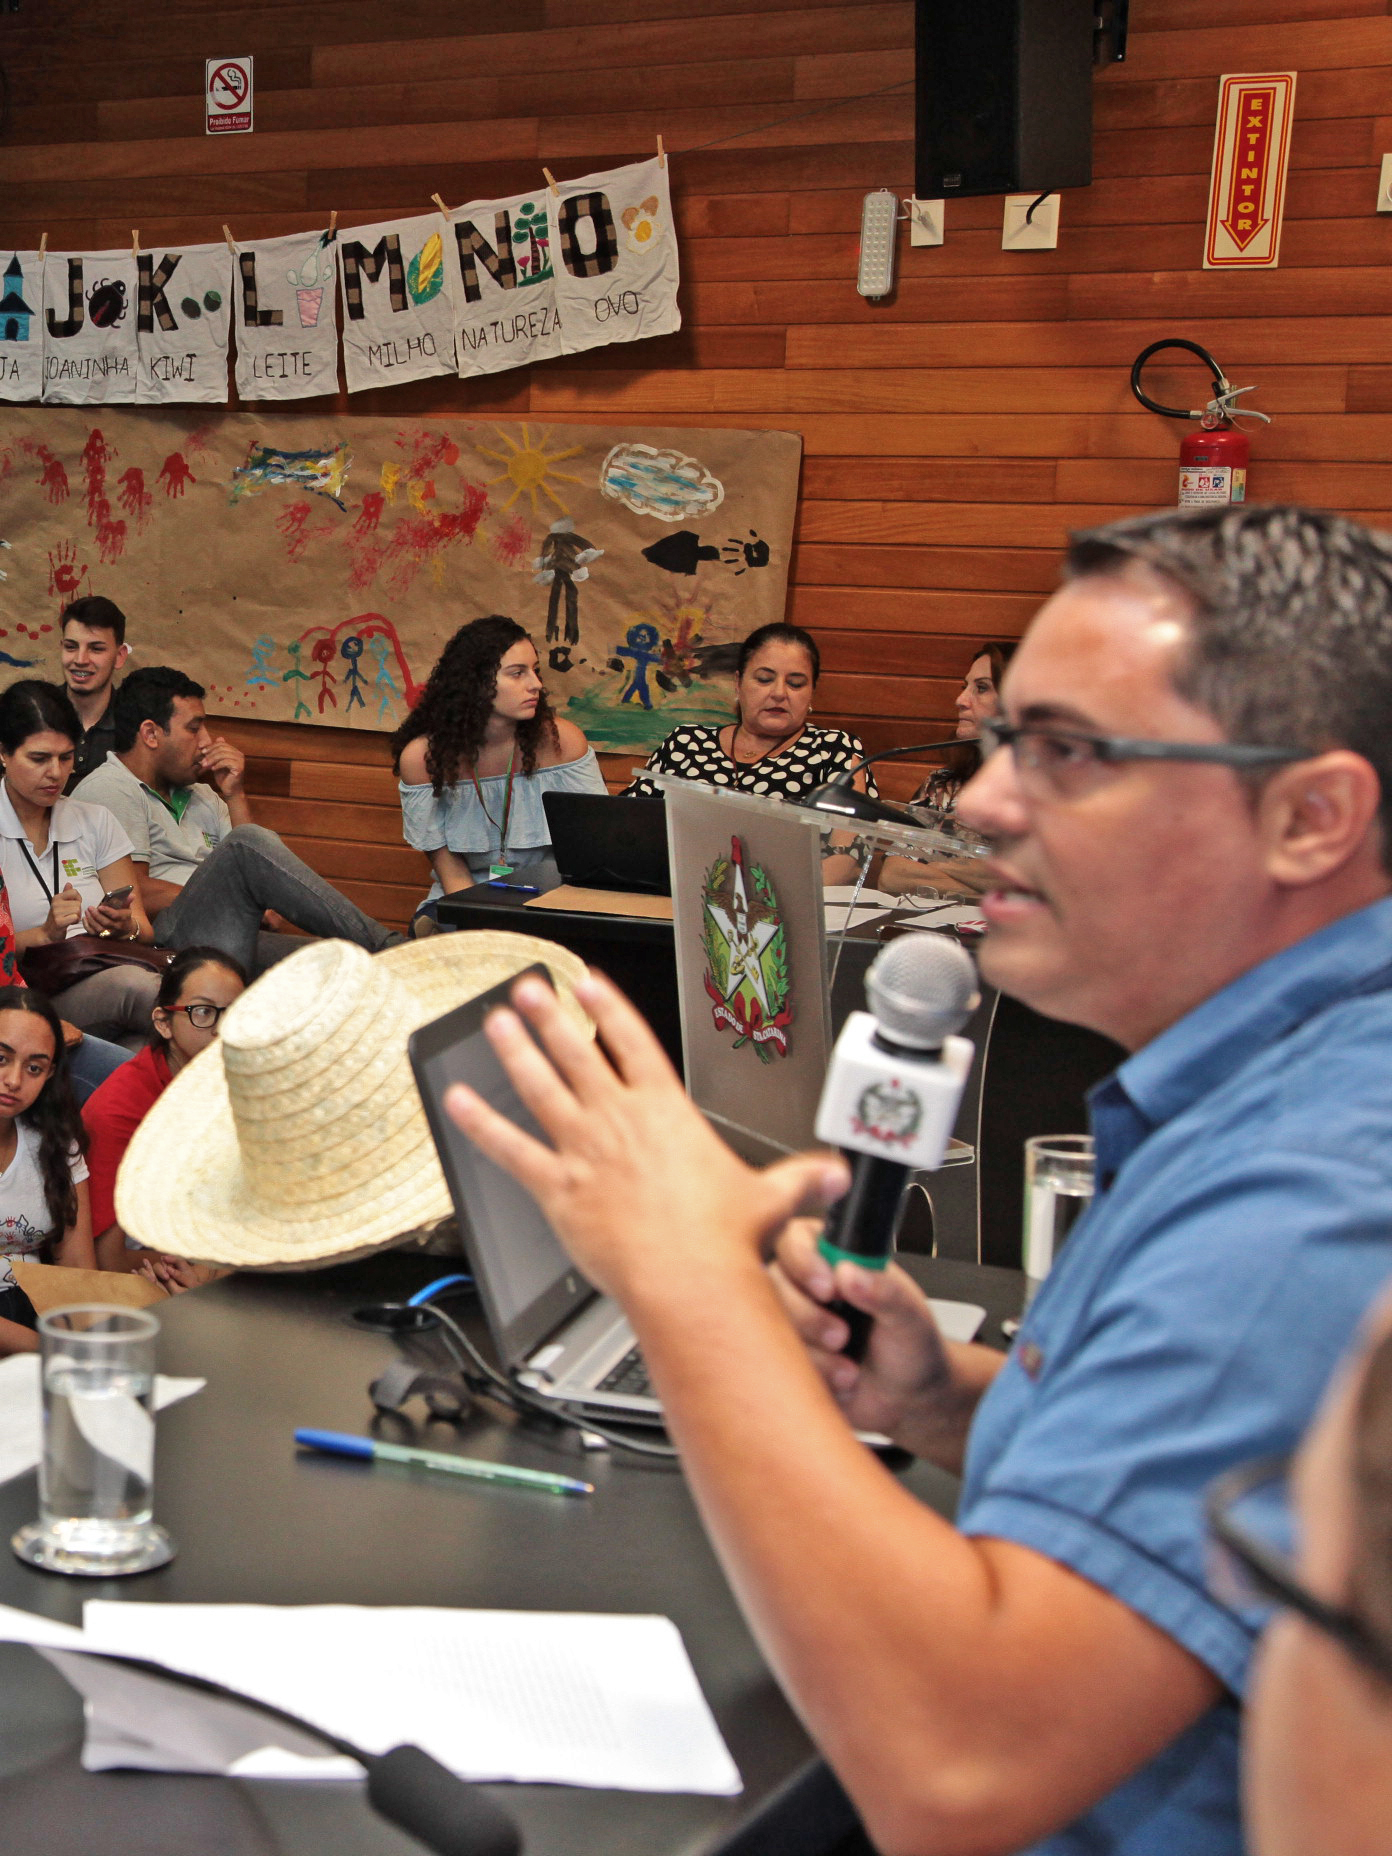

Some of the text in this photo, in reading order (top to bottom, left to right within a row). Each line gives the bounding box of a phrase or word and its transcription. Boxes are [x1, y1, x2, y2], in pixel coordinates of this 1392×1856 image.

[1237, 99, 1263, 231] EXTINTOR
[455, 210, 518, 304] N
[558, 191, 619, 280] O
[45, 257, 84, 338] J
[136, 253, 183, 333] K
[239, 251, 284, 327] L
[342, 233, 409, 321] M
[594, 289, 640, 323] OVO
[253, 351, 313, 379] LEITE
[368, 332, 438, 368] MILHO
[460, 306, 562, 351] NATUREZA
[44, 355, 130, 381] JOANINHA
[150, 353, 197, 382] KIWI
